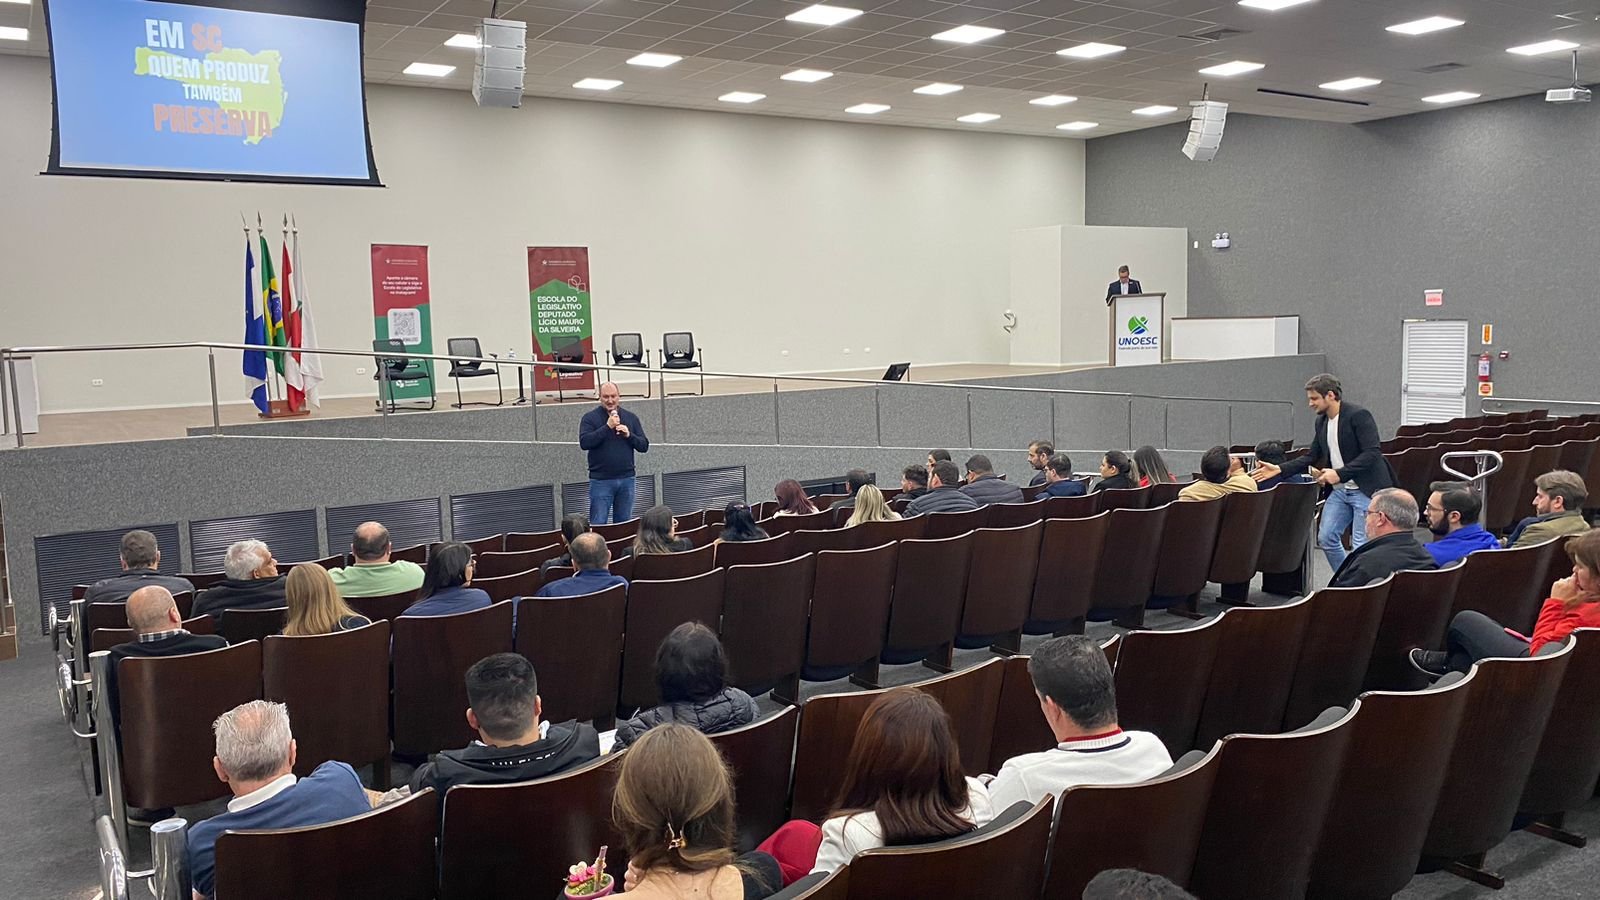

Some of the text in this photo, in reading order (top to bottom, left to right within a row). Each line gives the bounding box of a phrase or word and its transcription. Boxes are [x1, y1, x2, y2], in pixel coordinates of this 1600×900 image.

[145, 19, 223, 53] EM SC
[147, 55, 270, 84] QUEM PRODUZ
[182, 84, 242, 103] TAMBÉM
[154, 104, 273, 137] PRESERVA
[538, 317, 557, 325] LÍCIO
[1118, 336, 1158, 346] UNOESC
